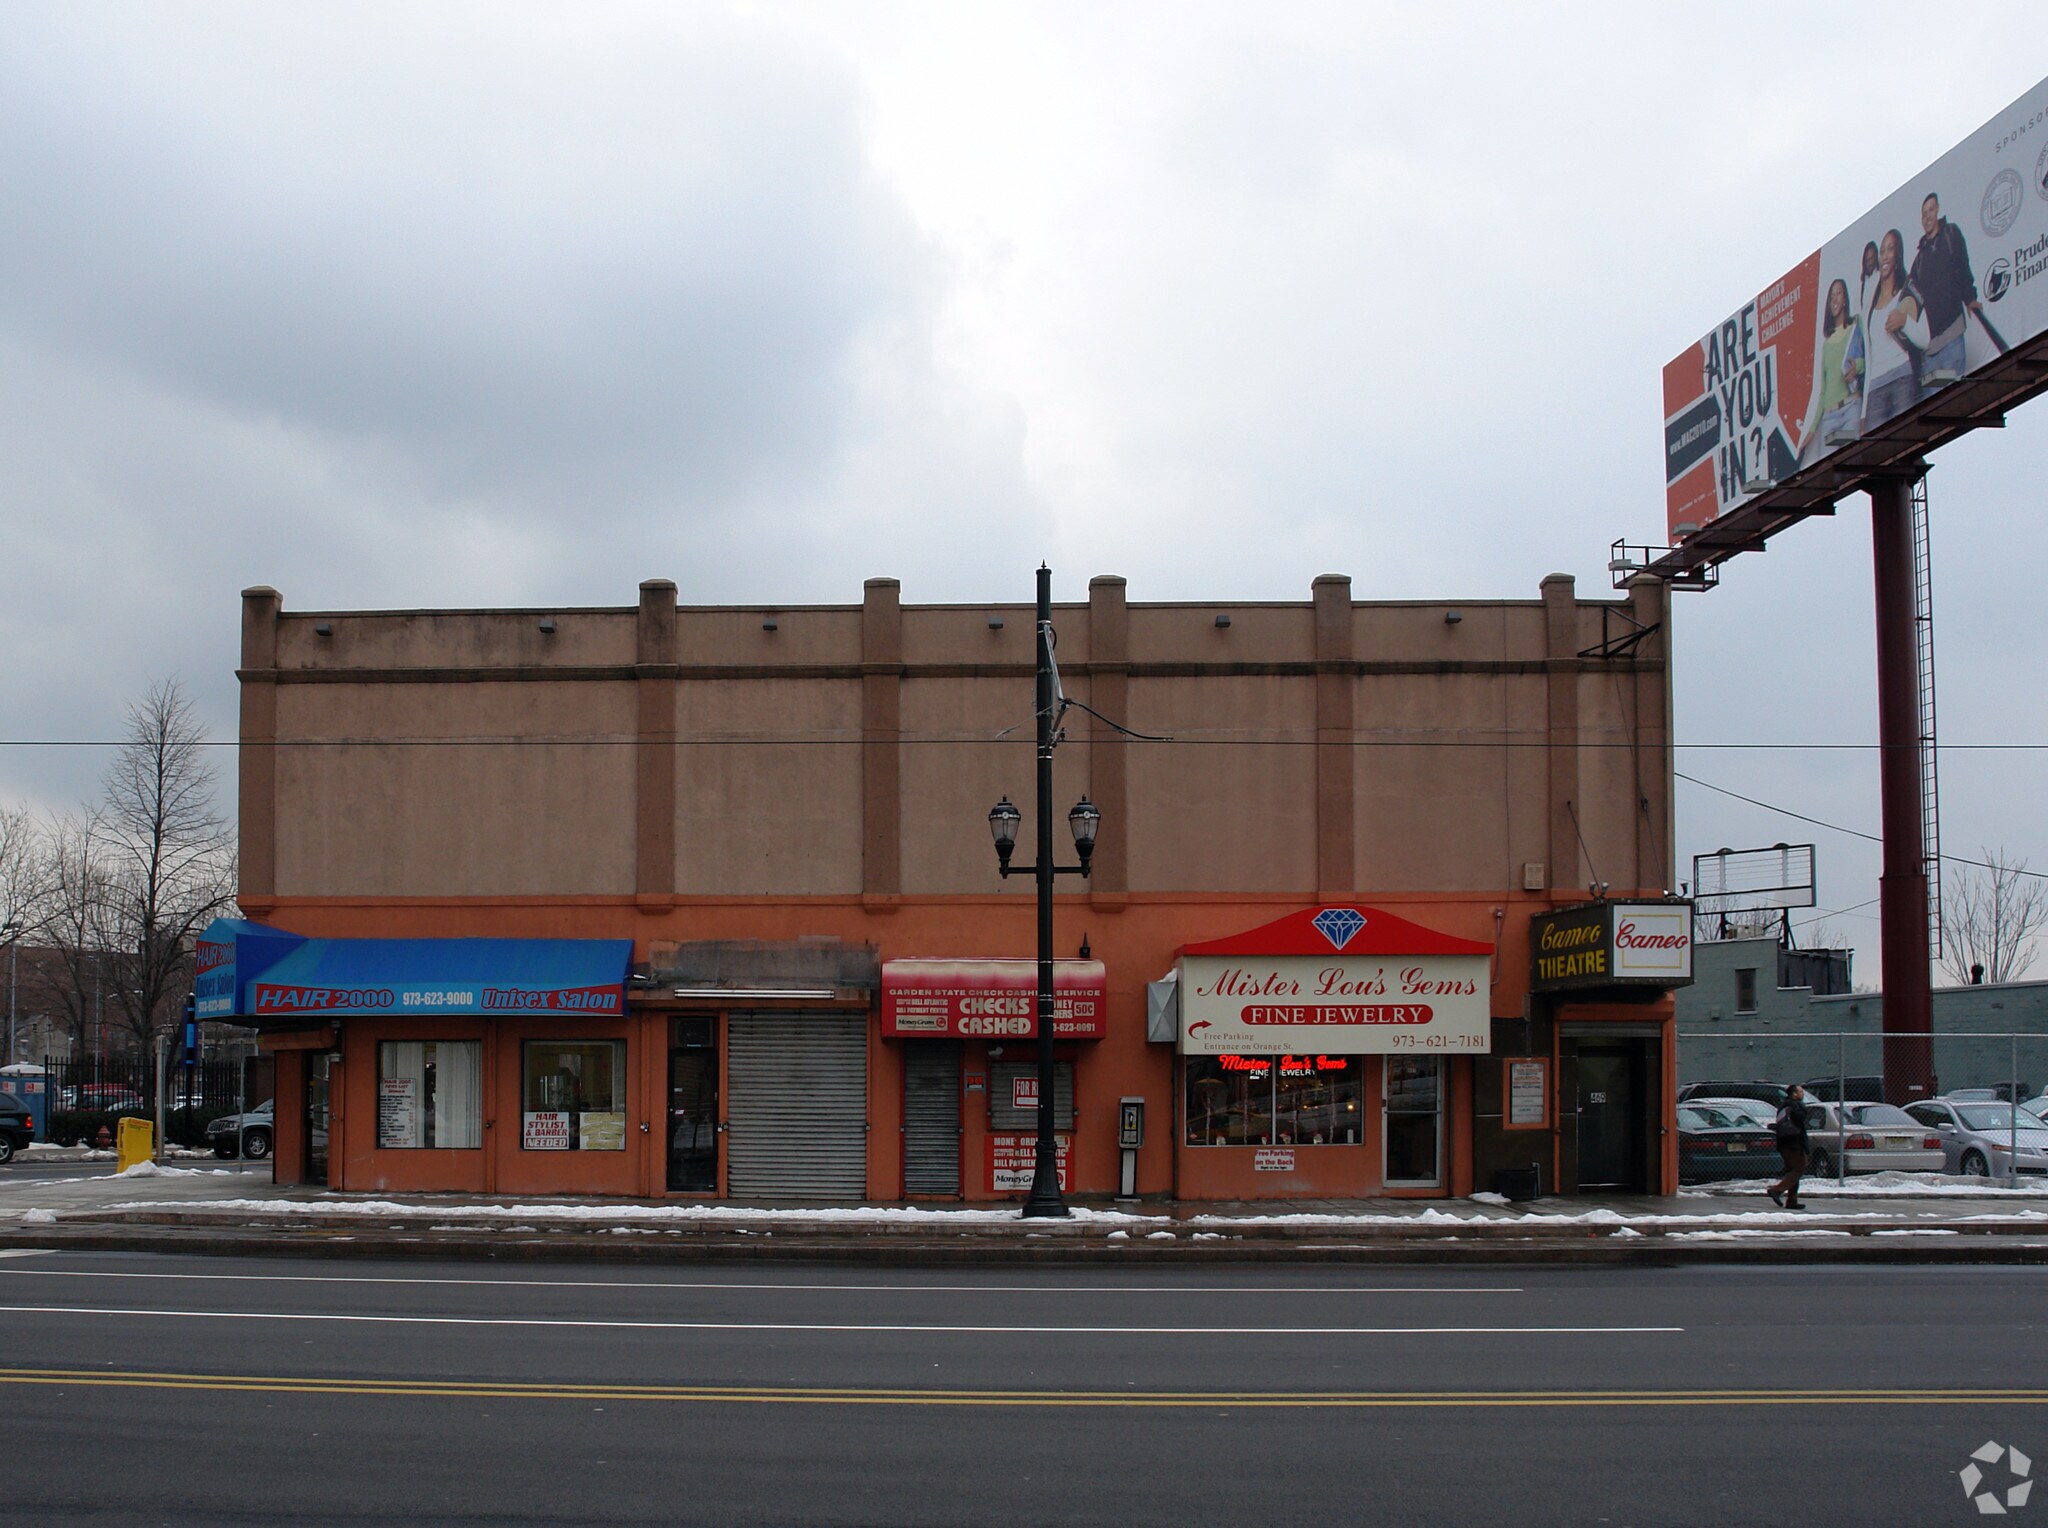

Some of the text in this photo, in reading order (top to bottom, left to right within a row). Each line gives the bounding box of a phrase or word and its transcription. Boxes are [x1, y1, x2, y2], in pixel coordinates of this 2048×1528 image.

[1761, 285, 1801, 326] ACHIEVEMENT
[1762, 309, 1794, 343] CHALLENGE
[1705, 303, 1757, 393] ARE
[1721, 354, 1773, 438] YOU
[1541, 922, 1601, 951] Cameo
[1615, 918, 1689, 950] Cameo
[196, 941, 236, 967] HAIR 2000
[1538, 949, 1606, 980] THEATRE
[1196, 966, 1479, 997] Mister Lou's Gems
[258, 988, 395, 1008] HAIR 2000
[402, 991, 473, 1006] 973-623-9000
[480, 988, 617, 1009] Unisex Salon
[959, 997, 1031, 1015] CHECKS
[1251, 1007, 1425, 1024] FINE JEWELRY
[957, 1017, 1032, 1035] CASHED
[1223, 1032, 1254, 1041] Parking
[1392, 1035, 1485, 1048] 973-621-7181
[1253, 1043, 1281, 1051] Orange
[1283, 1042, 1294, 1050] St.
[1219, 1053, 1347, 1071] Mister Lou's Gems
[1249, 1069, 1270, 1077] FINE
[1016, 1081, 1030, 1096] FOR
[528, 1121, 566, 1129] STYLIST
[534, 1129, 568, 1137] BARBER
[527, 1138, 567, 1147] NEEDED
[1270, 1149, 1294, 1157] Parking
[993, 1159, 1008, 1167] BILL
[1009, 1159, 1036, 1167] PAYMEN
